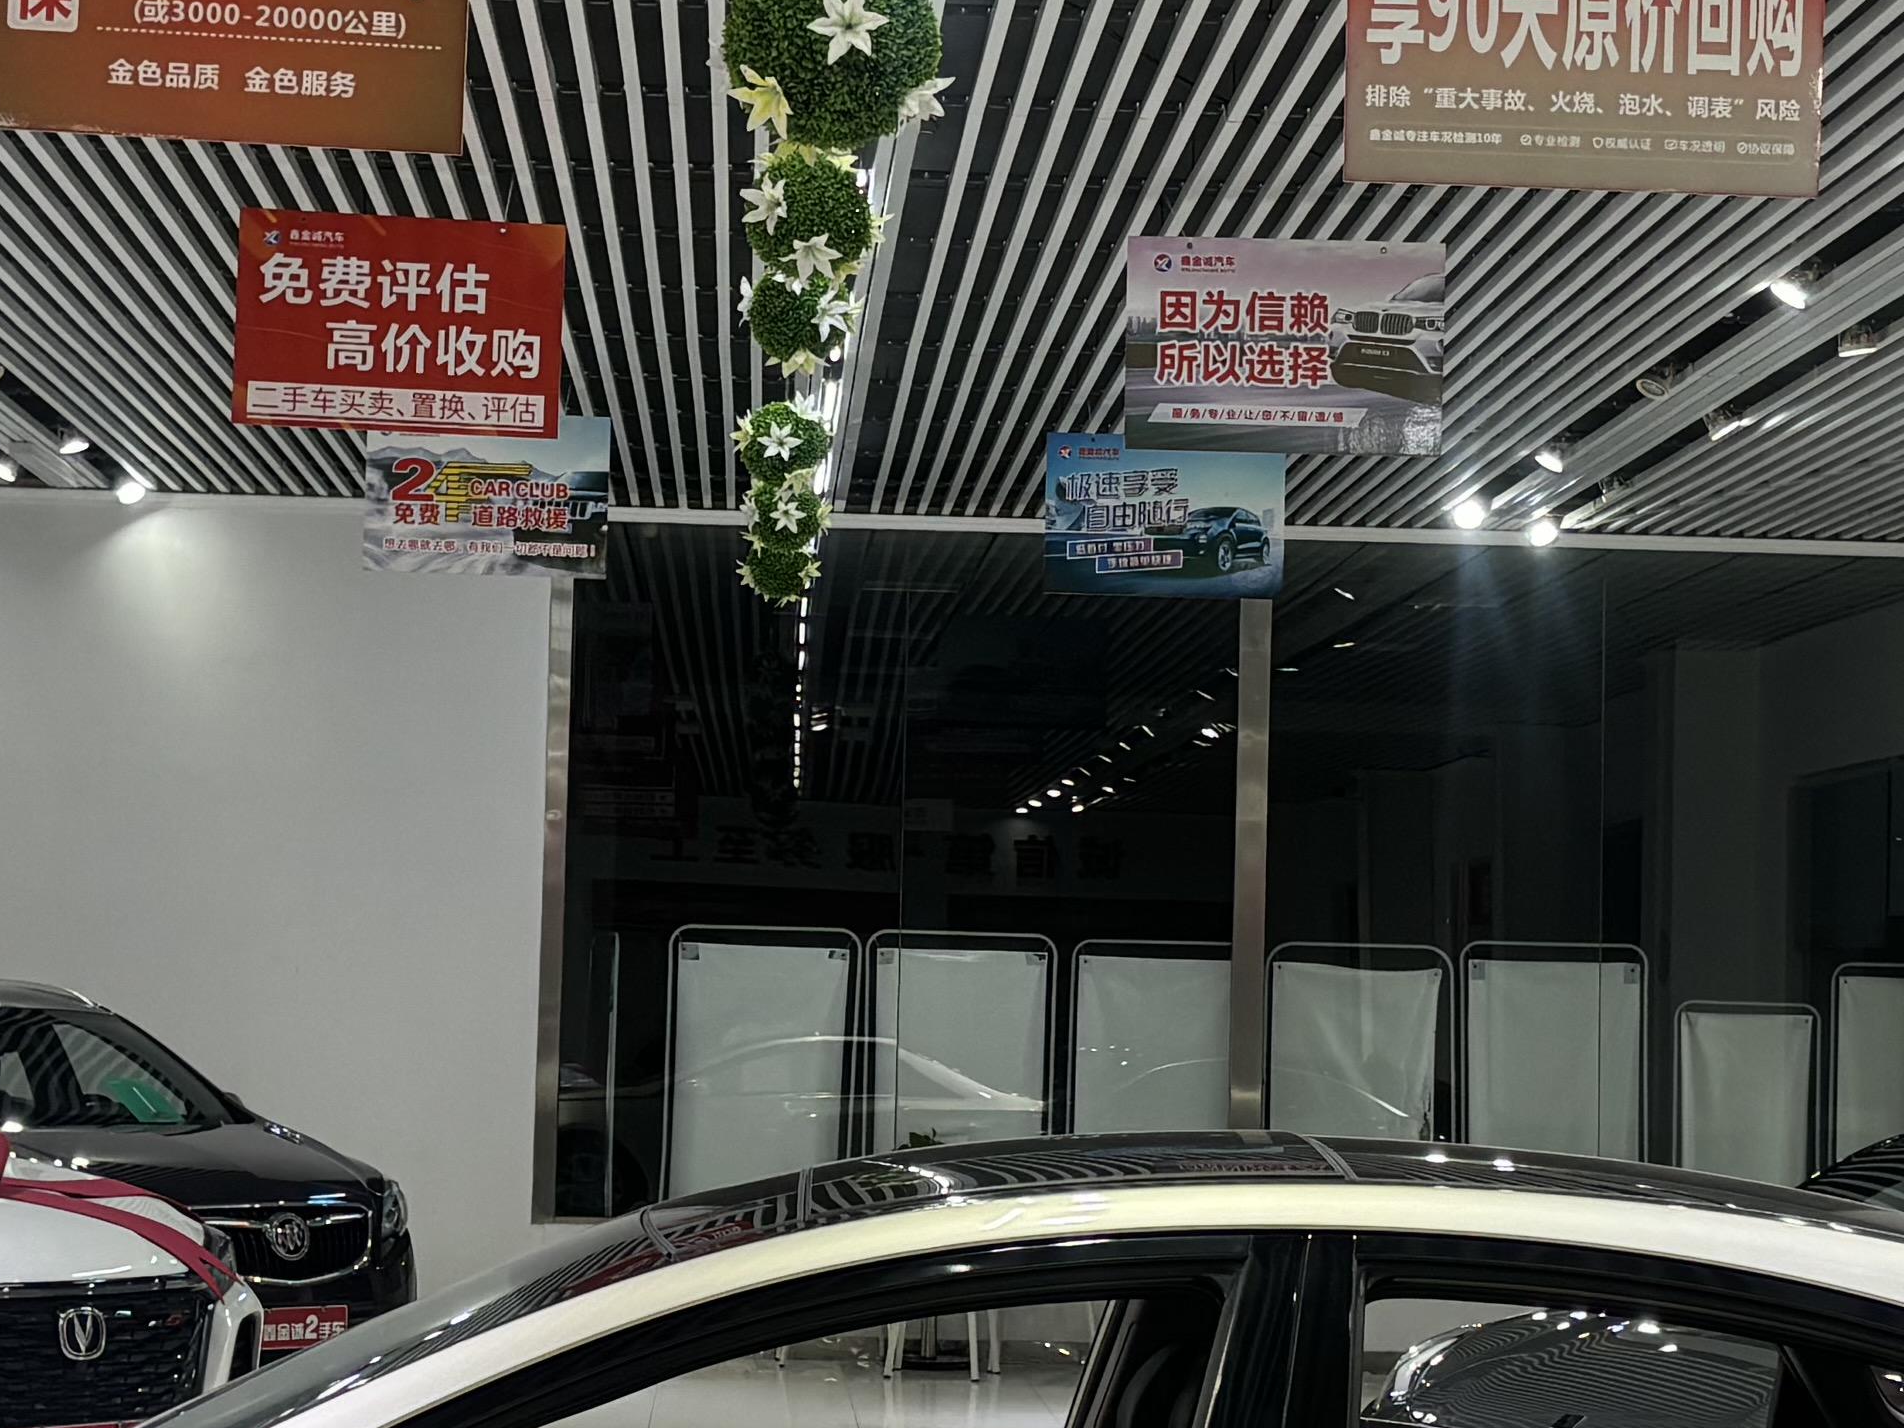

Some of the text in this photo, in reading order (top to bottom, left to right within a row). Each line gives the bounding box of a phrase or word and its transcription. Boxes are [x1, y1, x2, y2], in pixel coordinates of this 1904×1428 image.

[106, 58, 357, 99] 金色品质 金色服务
[258, 251, 491, 315] 免费评估
[1157, 289, 1331, 335] 因为信赖
[325, 320, 542, 379] 高价收购
[1155, 339, 1332, 389] 所以选择
[251, 385, 538, 425] 二手车买卖、置换、评估
[468, 479, 569, 500] CAR CLUB
[1063, 467, 1179, 502] 极速享受
[392, 503, 570, 531] 免费 道路救援
[1085, 498, 1190, 531] 自由随行
